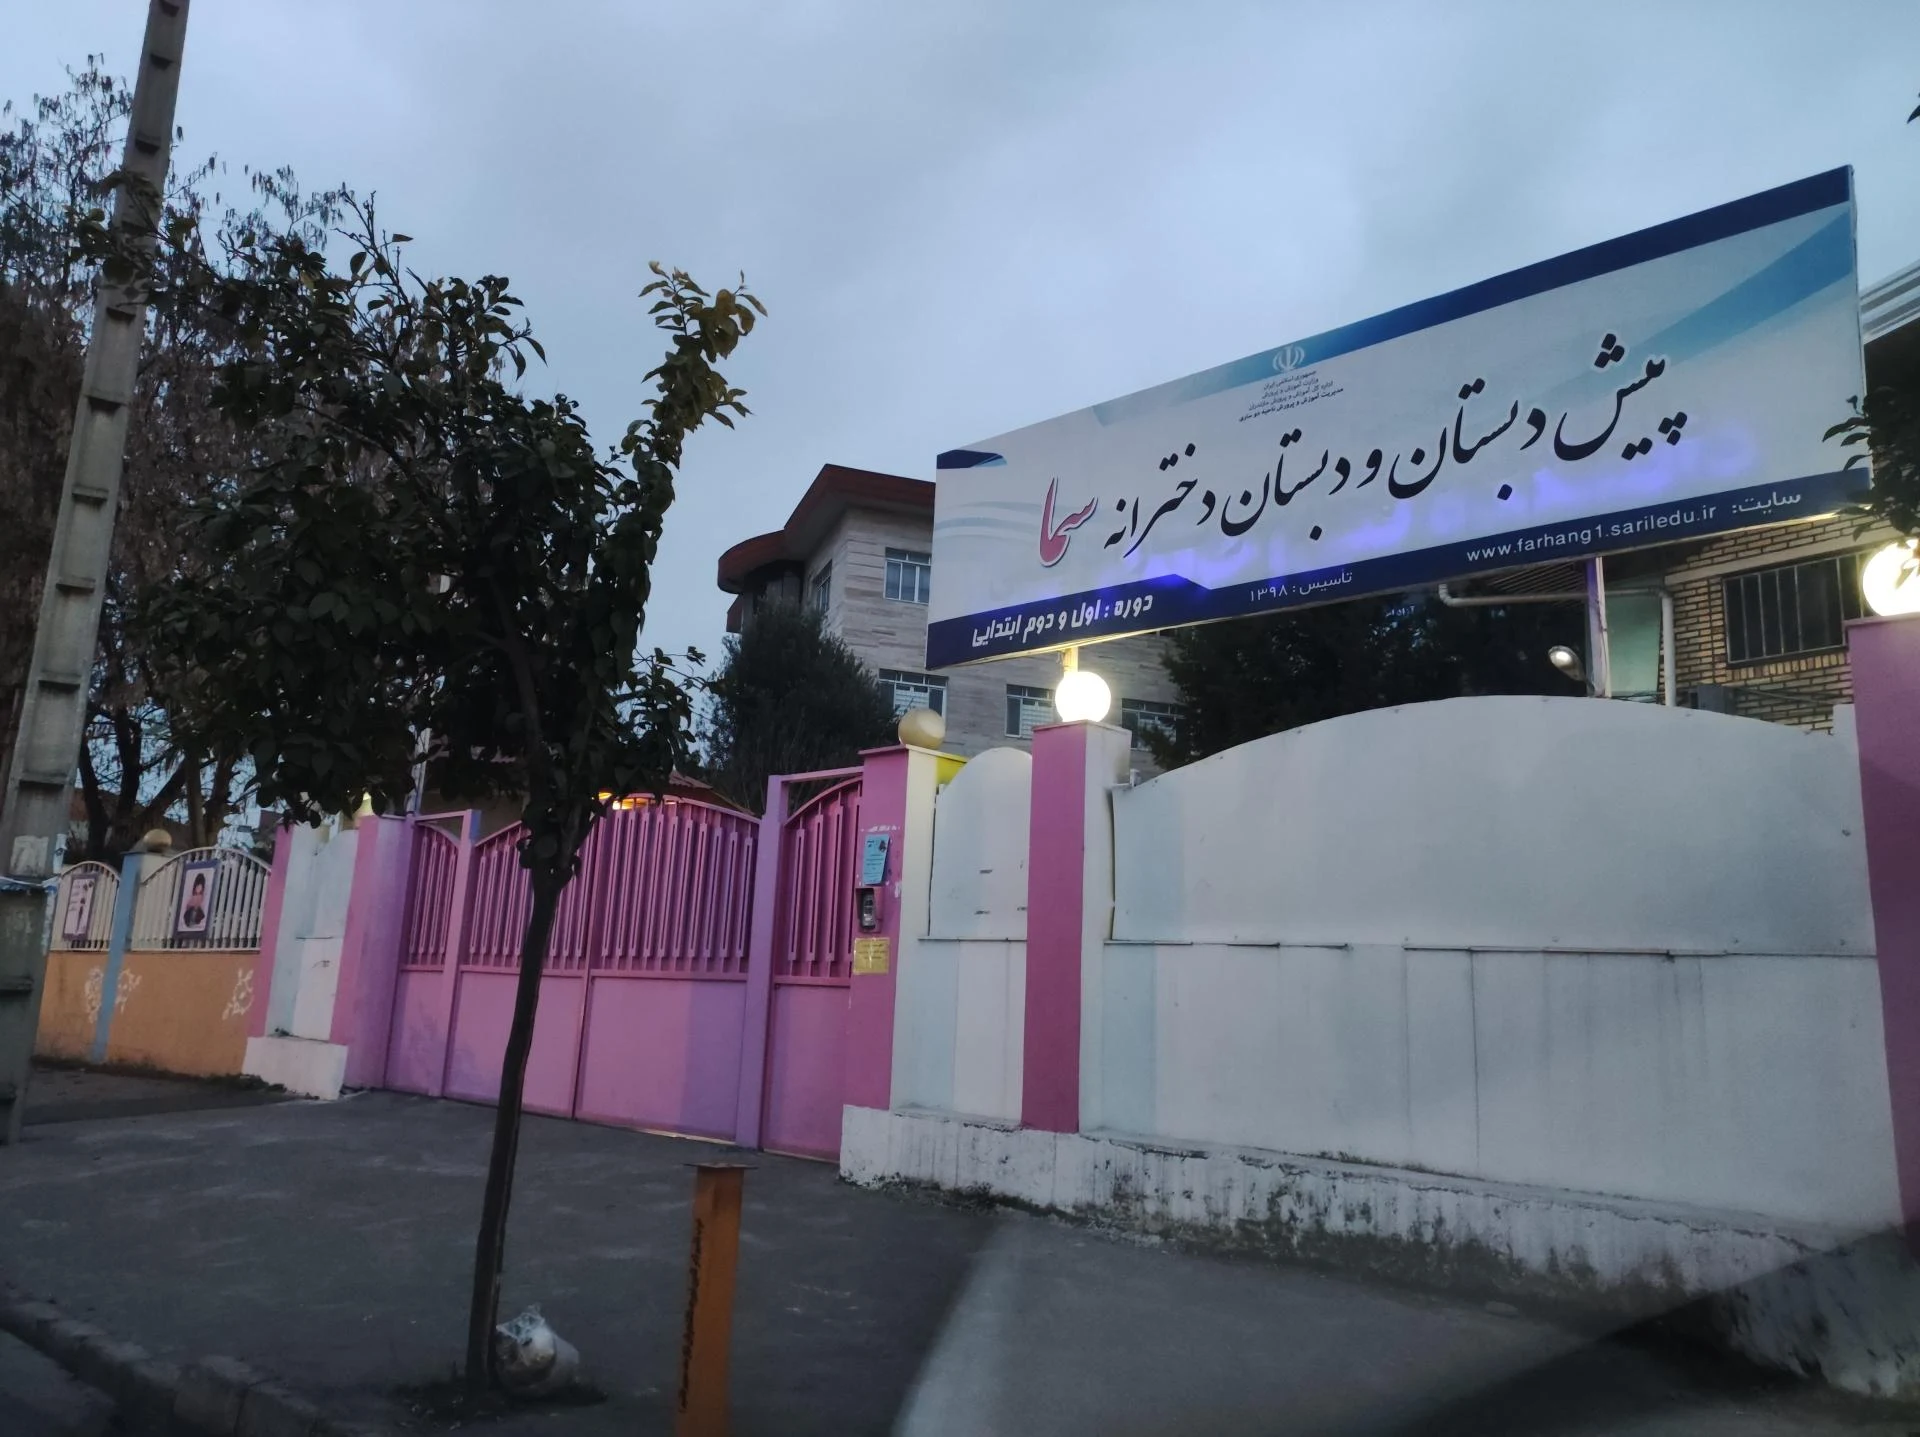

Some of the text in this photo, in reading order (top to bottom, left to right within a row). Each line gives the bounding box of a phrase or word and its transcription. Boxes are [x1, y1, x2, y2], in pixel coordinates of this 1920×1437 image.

[1040, 333, 1688, 567] پیش دبستان و دبستان دخترانه سما
[1250, 584, 1288, 602] ۱۳۹۸
[1022, 613, 1055, 644] دوم
[1058, 611, 1067, 631] و
[1071, 599, 1101, 628] اول
[972, 614, 1022, 648] ابتدایی
